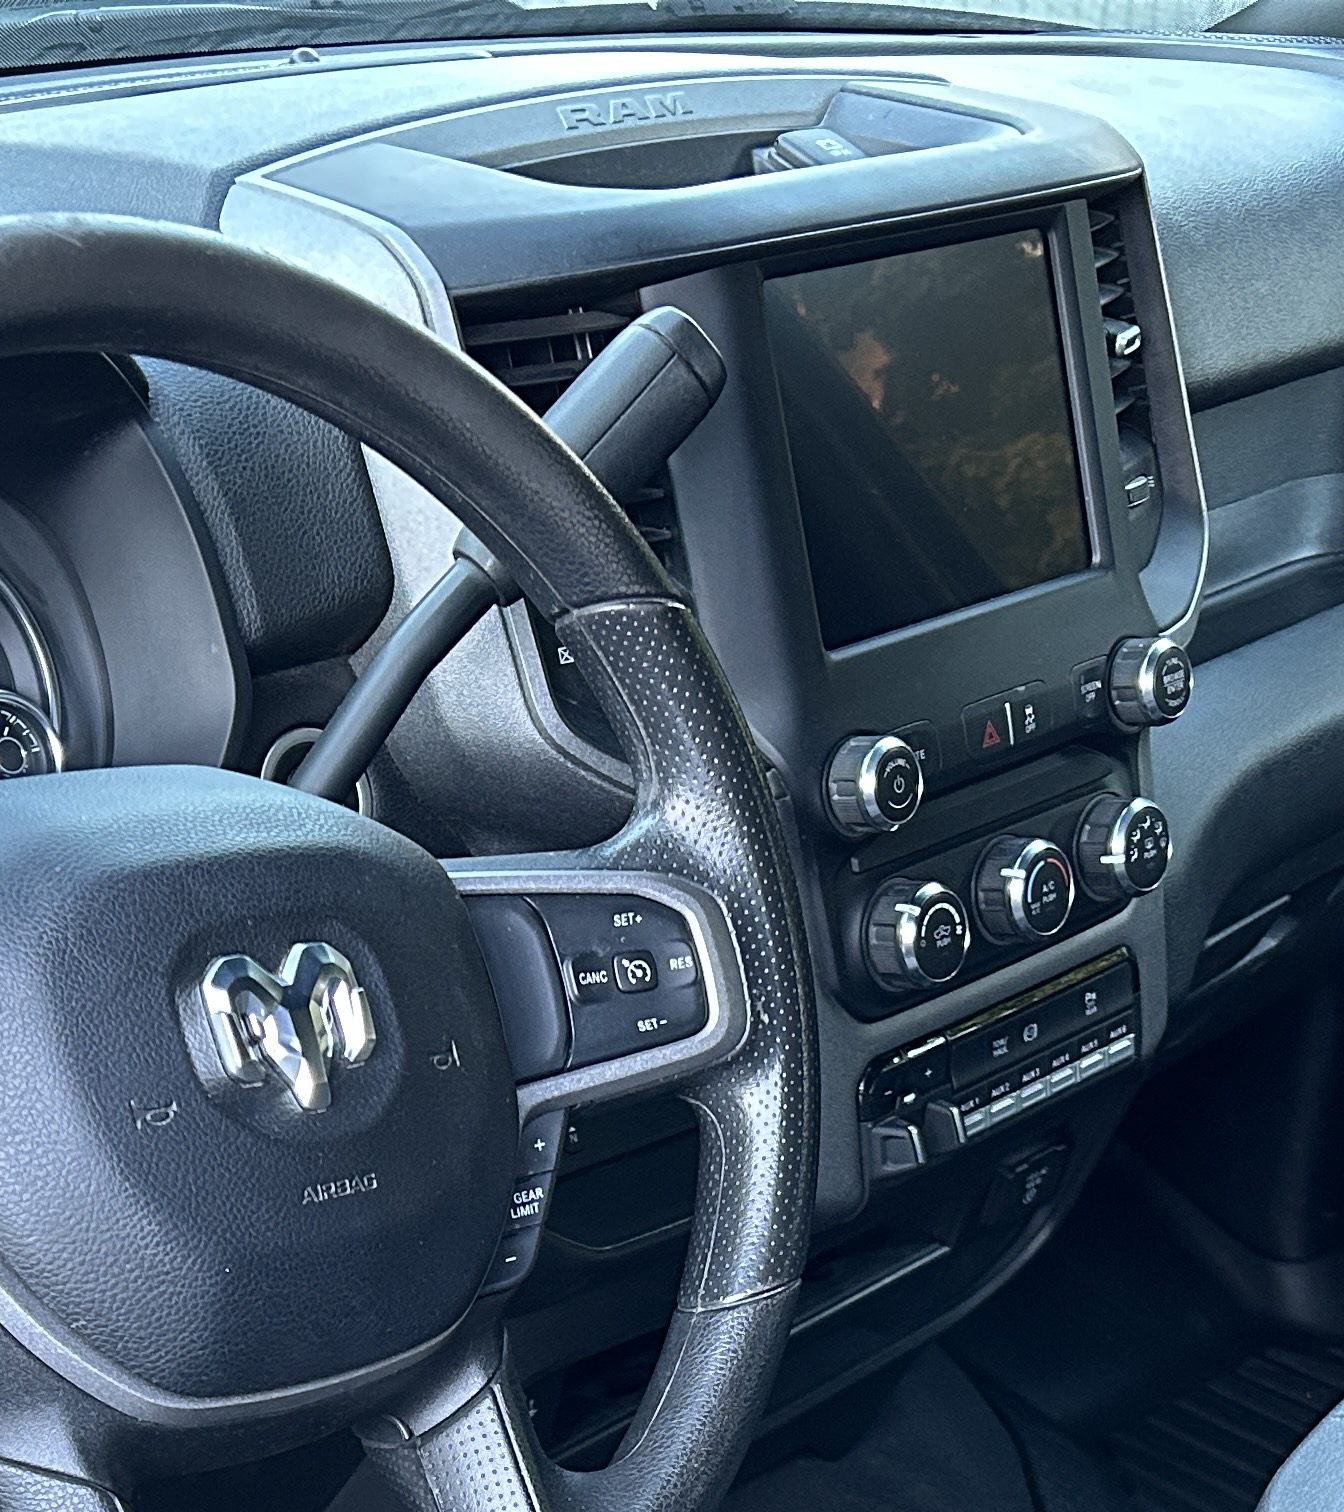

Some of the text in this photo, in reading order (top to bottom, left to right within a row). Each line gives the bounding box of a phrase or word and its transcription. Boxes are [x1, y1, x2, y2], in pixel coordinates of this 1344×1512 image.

[557, 91, 694, 134] RAM
[1080, 680, 1102, 695] SCREEN
[1085, 691, 1096, 703] OFF
[669, 955, 694, 971] RES
[578, 970, 609, 985] CANC
[1109, 1027, 1123, 1039] AUX
[1080, 1041, 1094, 1054] AUX
[1052, 1055, 1065, 1069] AUX
[1022, 1070, 1036, 1083] AUX
[991, 1084, 1005, 1098] AUX
[960, 1099, 975, 1112] AUX
[302, 1172, 378, 1205] AIRBAG
[513, 1186, 544, 1204] GEAR
[510, 1201, 540, 1219] LIMIT
